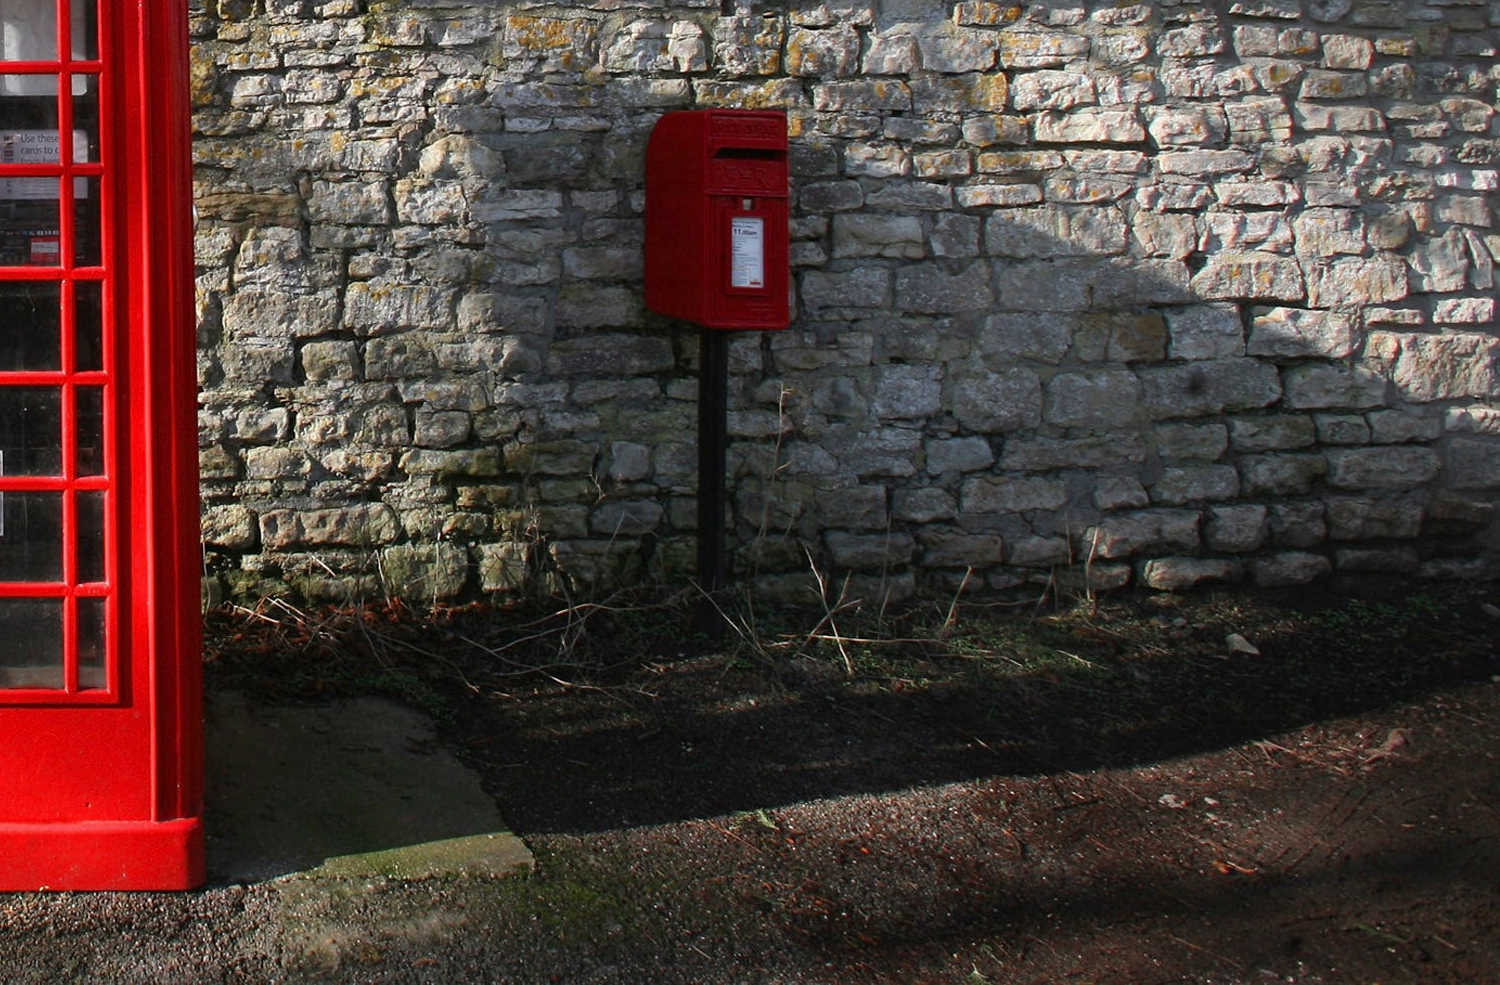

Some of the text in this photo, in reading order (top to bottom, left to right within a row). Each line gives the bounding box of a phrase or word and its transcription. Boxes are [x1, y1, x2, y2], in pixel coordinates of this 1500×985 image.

[20, 134, 35, 143] Use
[20, 146, 43, 154] cards
[44, 146, 54, 154] to
